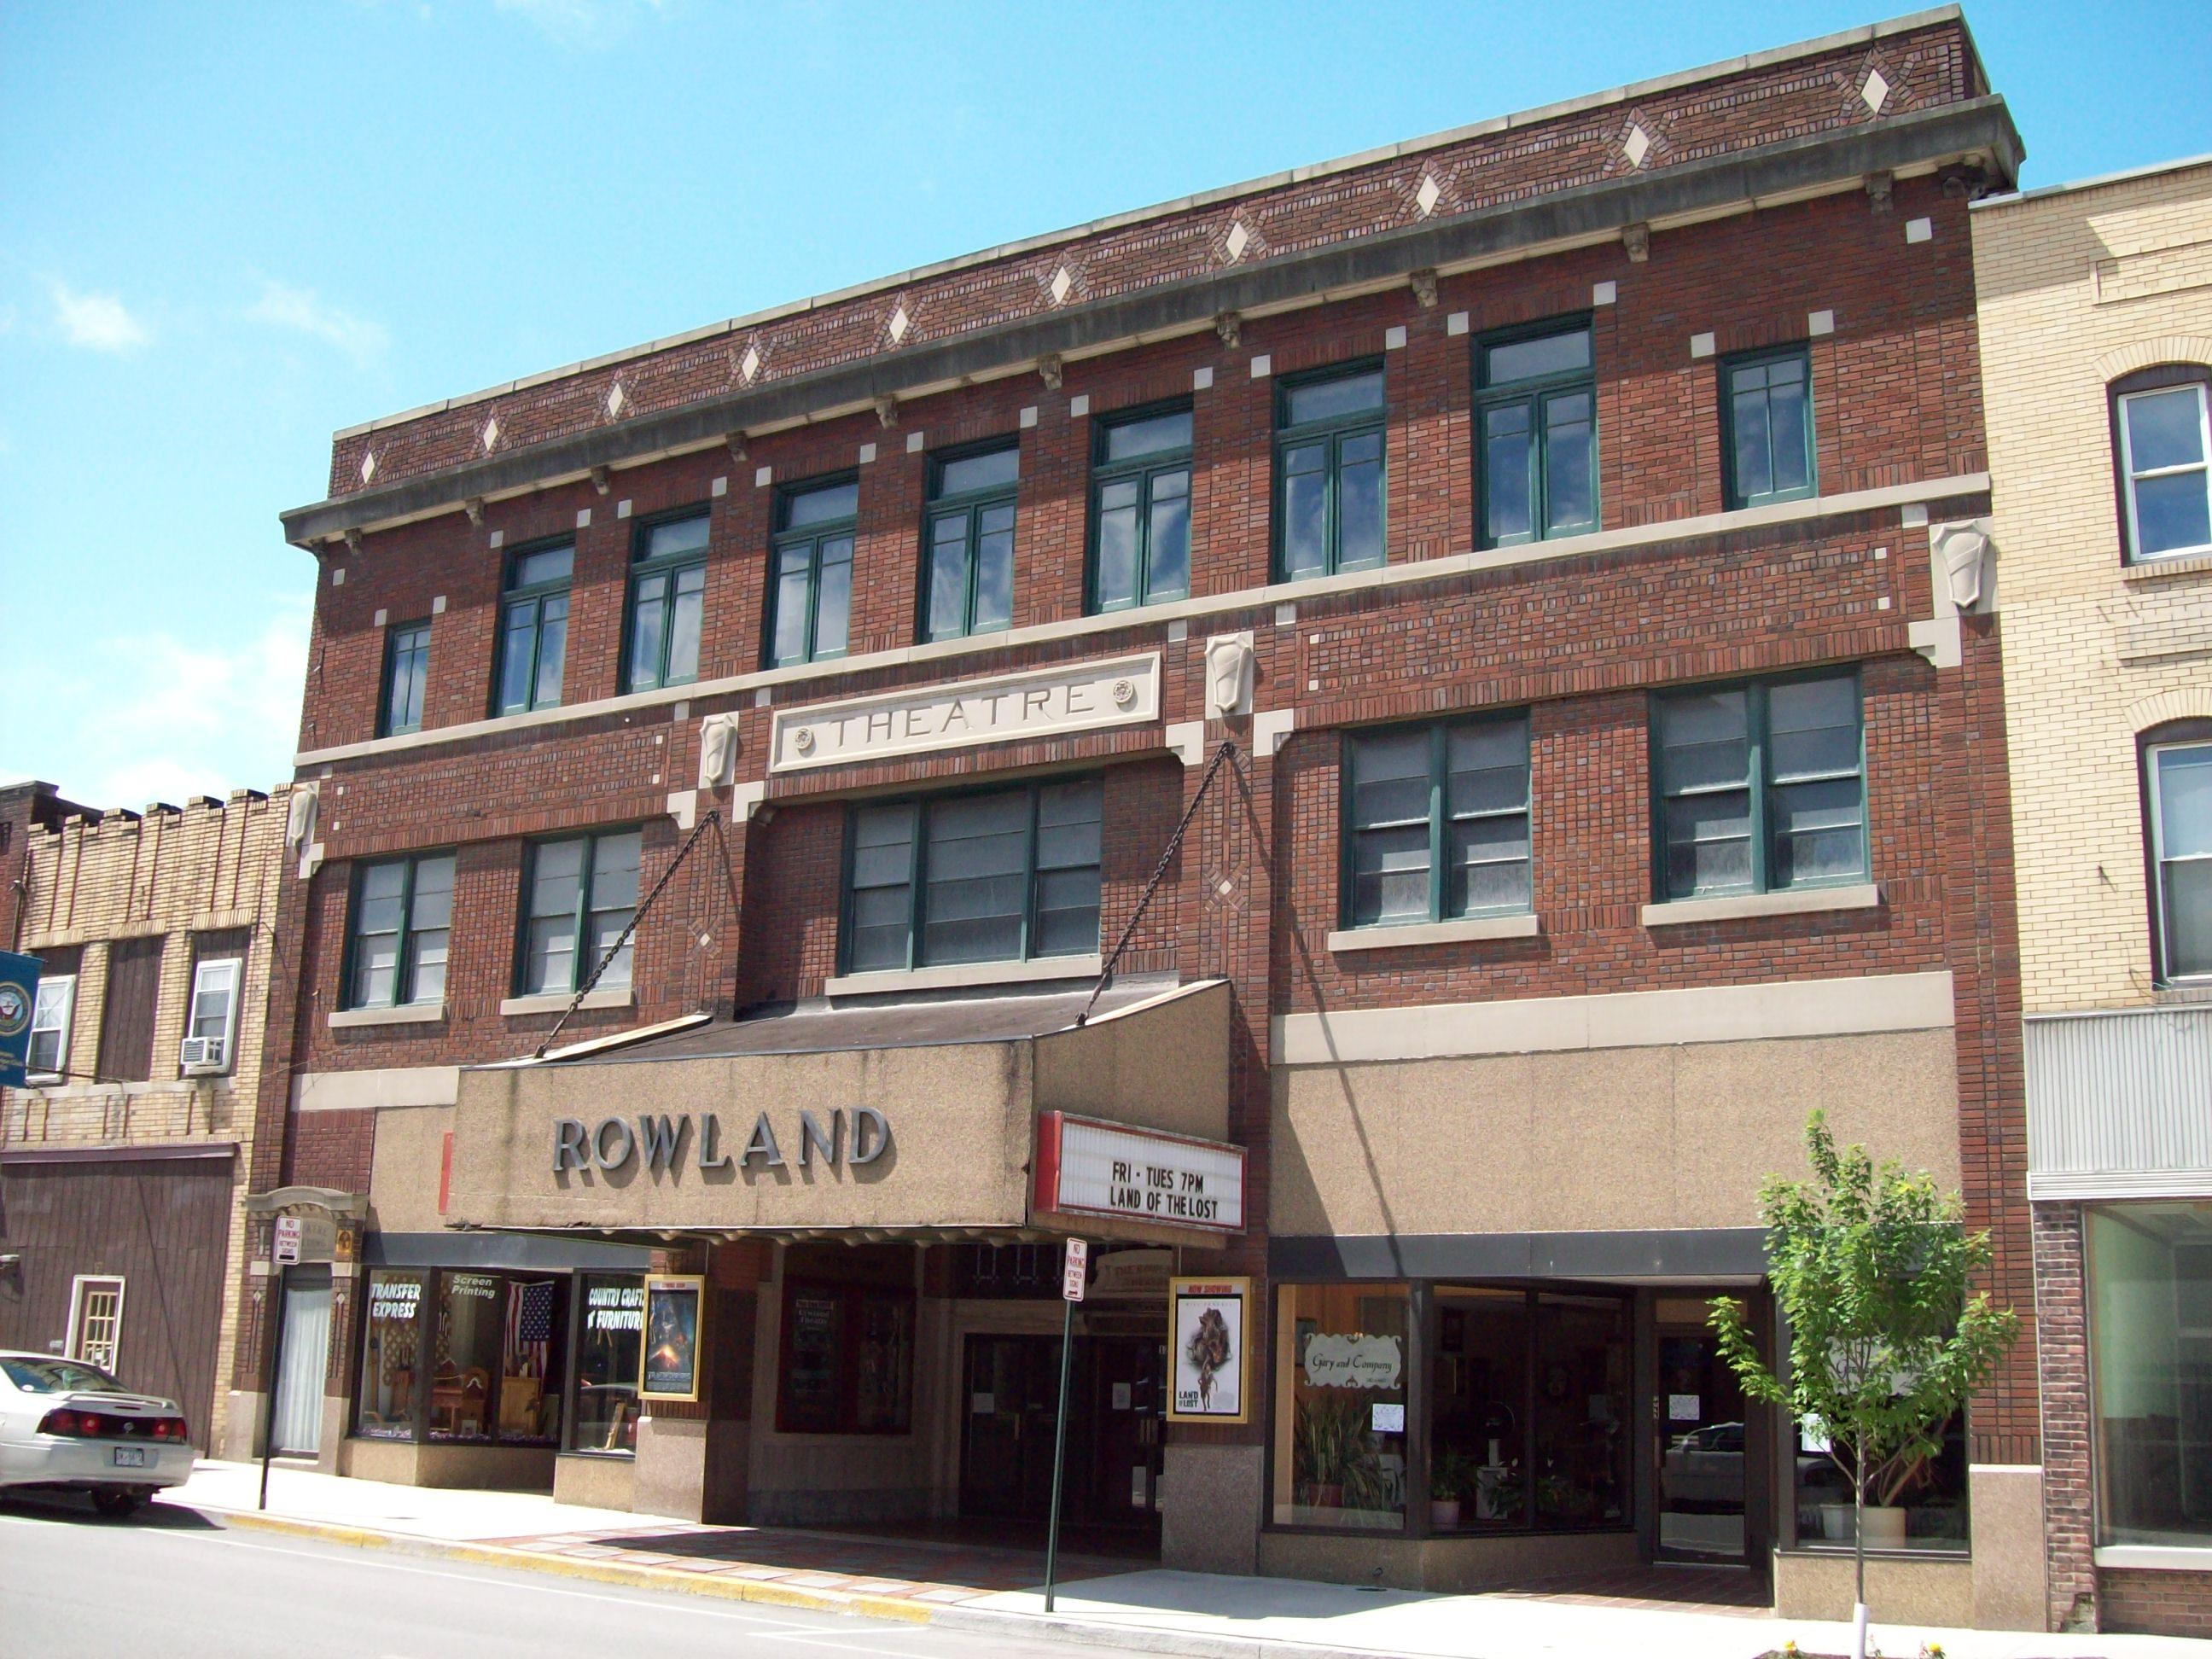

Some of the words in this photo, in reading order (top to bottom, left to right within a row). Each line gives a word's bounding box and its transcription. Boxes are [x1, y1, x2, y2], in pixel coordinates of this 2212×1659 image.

[830, 681, 1096, 748] THEATRE
[552, 1106, 889, 1172] ROWLAND
[1112, 1161, 1132, 1183] FRI
[1146, 1167, 1174, 1189] TUES
[1181, 1172, 1203, 1194] 7PM
[1110, 1185, 1141, 1208] LAND
[1146, 1191, 1161, 1212] OF
[286, 1219, 295, 1229] NO
[278, 1230, 301, 1239] PARKING
[1074, 1243, 1081, 1254] NO
[1067, 1255, 1086, 1268] PARKING
[452, 1274, 492, 1287] Screen
[1067, 1270, 1082, 1279] BETWEEN
[371, 1283, 422, 1301] TRANSFER
[451, 1284, 496, 1299] Printing
[588, 1287, 621, 1307] COUNTRY
[621, 1287, 644, 1307] CRAFT
[372, 1301, 417, 1318] EXPRESS
[1313, 1353, 1334, 1372] Gary
[1336, 1357, 1350, 1368] and
[1353, 1354, 1393, 1373] Company
[1179, 1391, 1199, 1400] LAND
[1183, 1400, 1199, 1408] LOST
